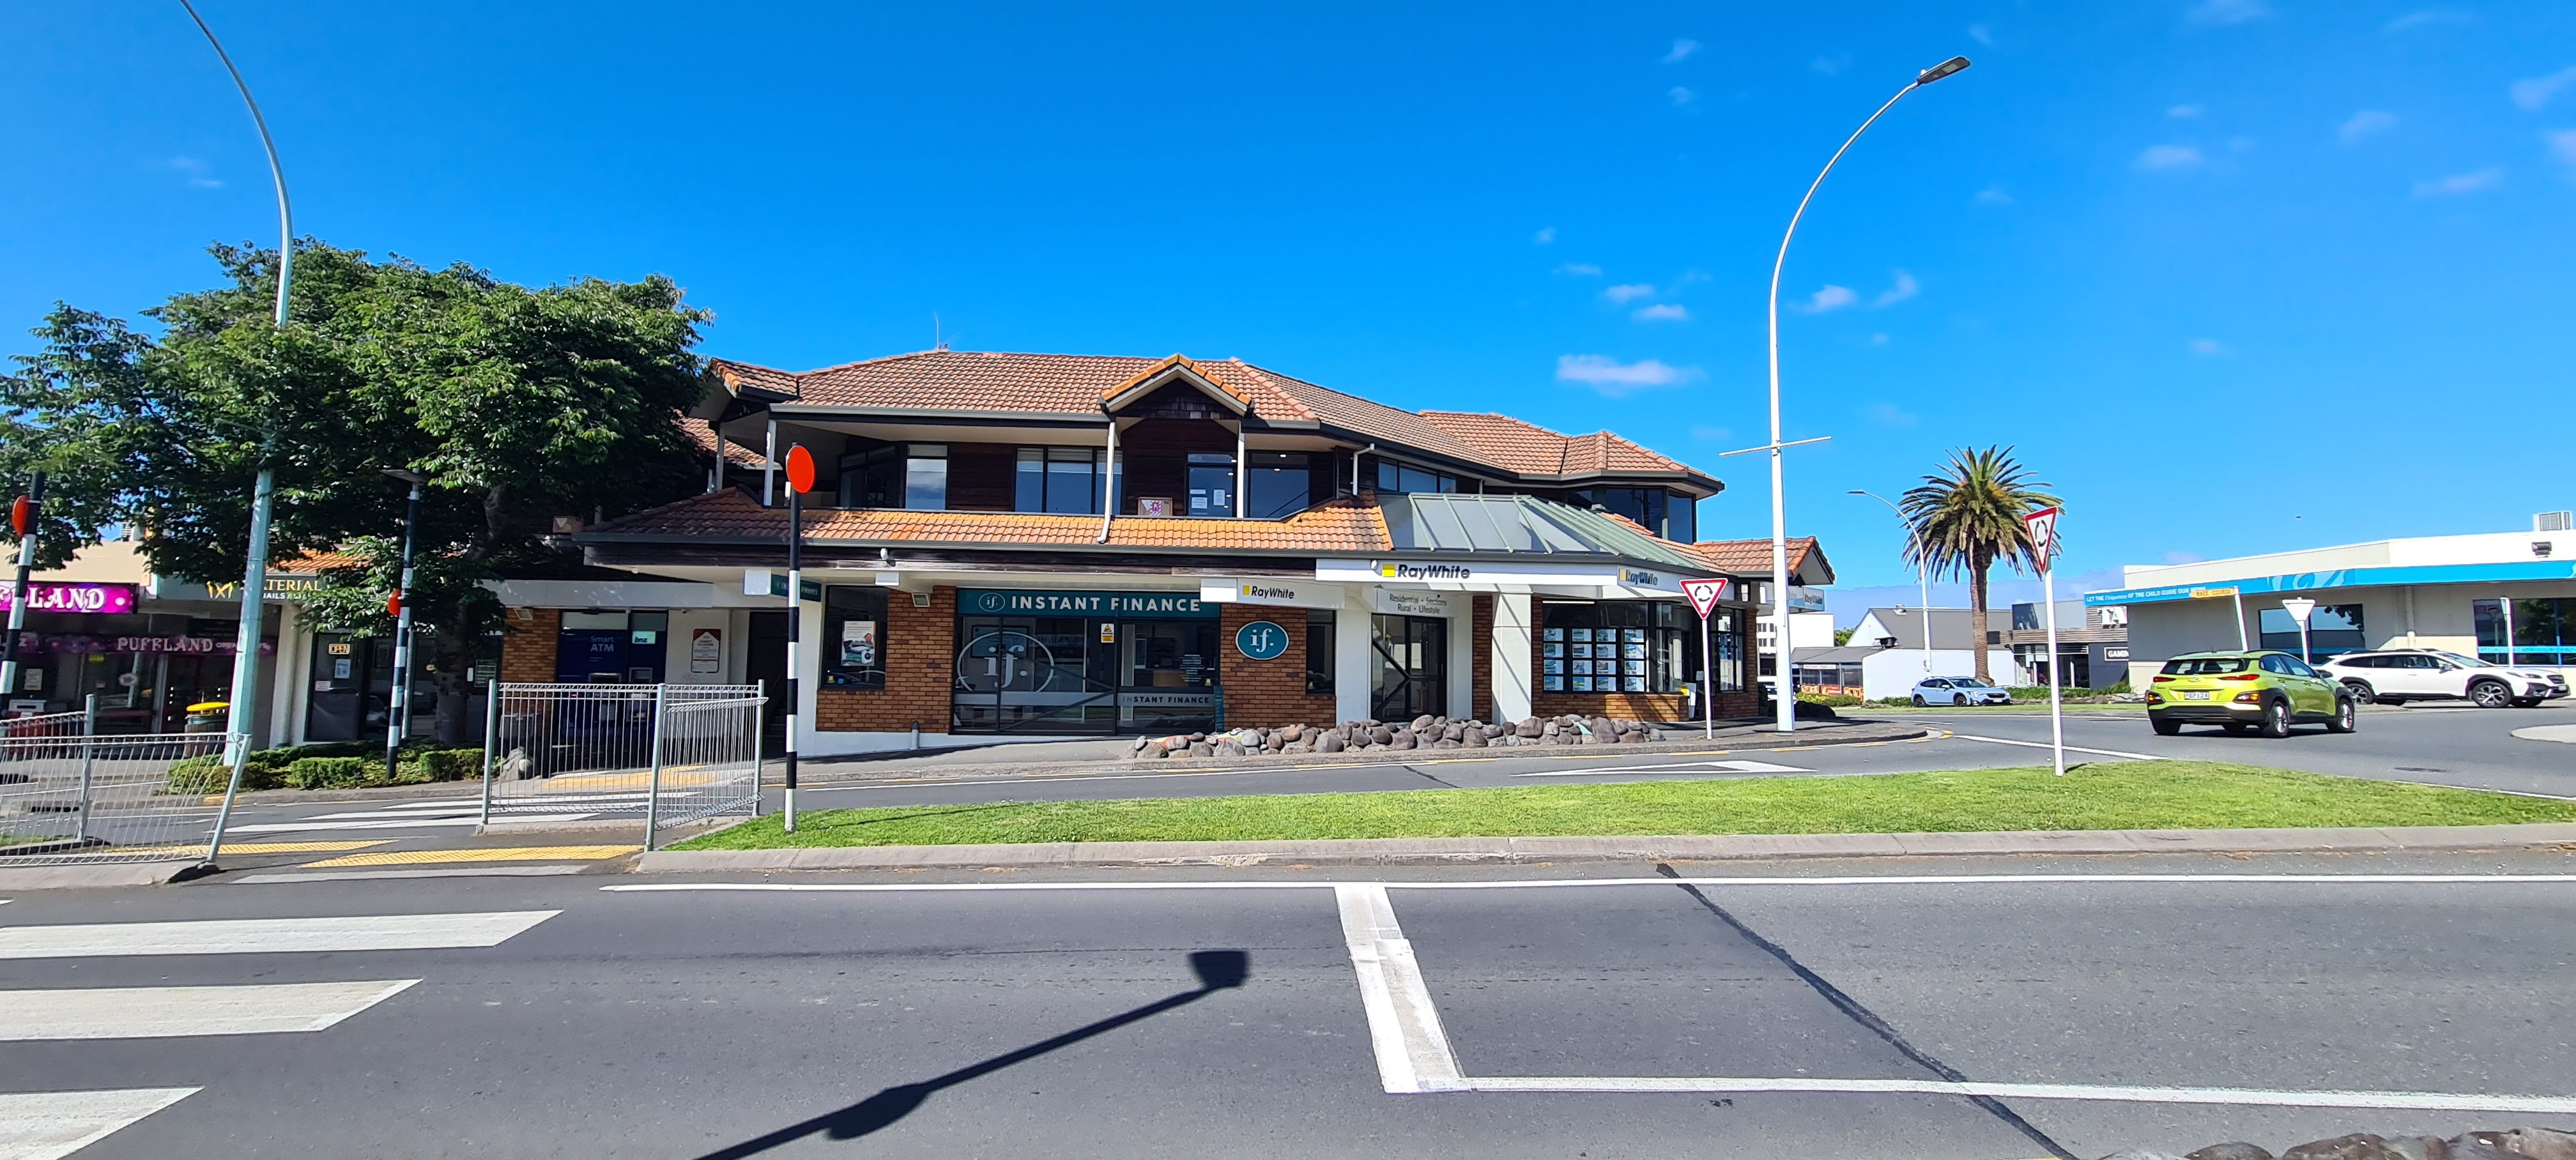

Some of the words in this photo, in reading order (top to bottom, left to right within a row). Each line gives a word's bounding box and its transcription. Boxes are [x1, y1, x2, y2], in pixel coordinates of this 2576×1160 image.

[1398, 564, 1471, 580] RayWhite
[1251, 586, 1294, 599] RayWhite
[1011, 596, 1101, 611] INSTANT
[1110, 597, 1201, 612] FINANCE
[117, 637, 214, 652] PUFFLAND
[331, 644, 349, 653] OPEN
[590, 643, 615, 652] ATM
